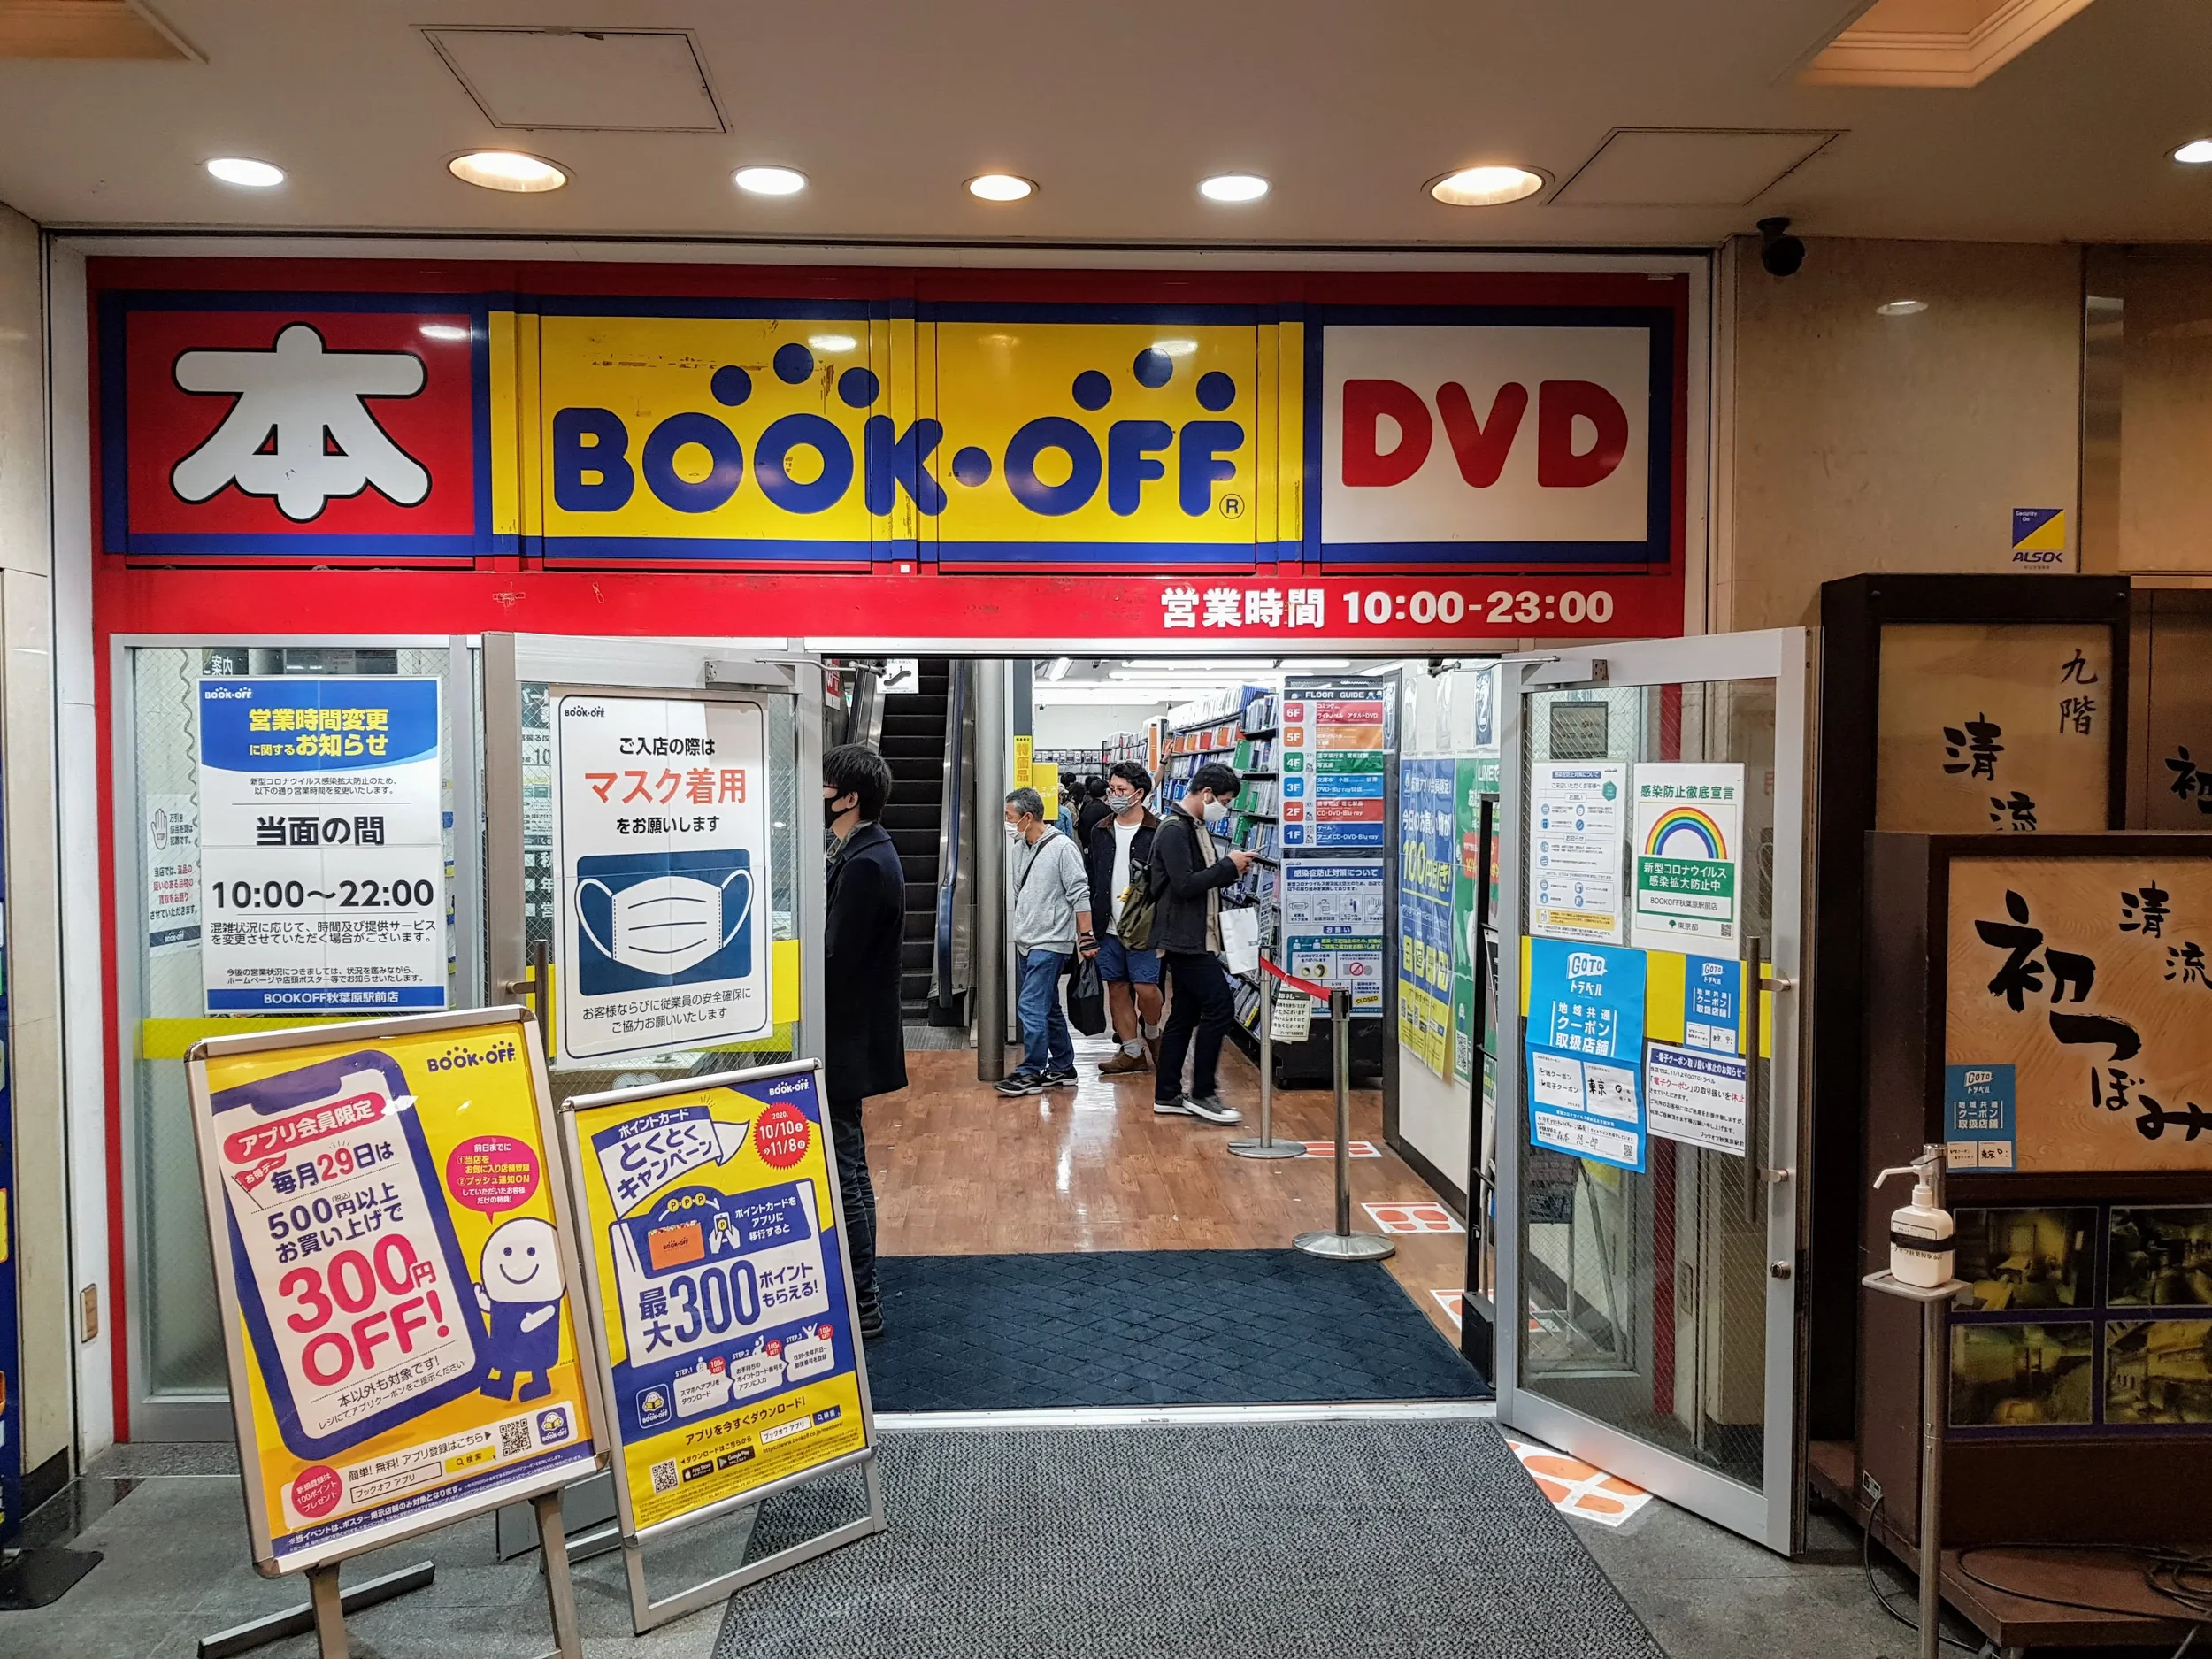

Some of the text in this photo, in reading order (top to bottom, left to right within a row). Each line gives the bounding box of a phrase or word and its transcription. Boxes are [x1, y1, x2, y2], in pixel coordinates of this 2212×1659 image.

[172, 320, 432, 523] 本
[1342, 379, 1629, 488] DVD
[2012, 552, 2063, 563] ALSOK
[1160, 588, 1615, 629] 営業時間 10:00-23:00
[204, 655, 233, 675] 案内
[2060, 649, 2098, 735] 九階
[249, 709, 389, 732] 営業時間変更
[1286, 709, 1300, 718] 6F
[250, 735, 388, 756] に関するお知らせ
[619, 737, 716, 756] ご入店の際は
[1286, 758, 1300, 767] 4F
[250, 777, 397, 786] 新型コロナウイルス感染拡大防止のため、
[585, 768, 746, 804] マスク着用
[1286, 783, 1301, 792] 3F
[1640, 785, 1735, 800] 感染防止徹底宣言
[1286, 808, 1301, 817] 2F
[256, 816, 385, 846] 当面の間
[616, 815, 720, 833] をお願いします
[1286, 831, 1301, 840] 1F
[1644, 862, 1727, 879] 新型コロナウイルス
[1649, 875, 1721, 892] 感染拡大防止中
[1650, 897, 1717, 910] BOOKOFF秋葉原駅前店
[210, 921, 436, 933] 混雑状況に応じて、時間及び提供サービス
[1678, 921, 1698, 931] 東京都
[2119, 879, 2212, 989] 清流
[211, 933, 432, 945] を変更させていただく場合がございます。
[264, 991, 399, 1004] BOOKOFF秋葉原駅前店
[1570, 980, 1602, 997] トラベル
[583, 988, 751, 1020] お客様ならびに従業員の安全確保に
[611, 1007, 727, 1033] ご協力お願いいたします
[1557, 1015, 1609, 1036] クーポン
[1555, 1032, 1609, 1056] 取扱店舗
[1546, 1081, 1578, 1094] 電子クーポン
[1587, 1078, 1607, 1096] 東京
[238, 1100, 375, 1156] アプリ会員限定
[618, 1109, 689, 1139] ポイントカード
[474, 1143, 511, 1153] 前日までに
[620, 1124, 698, 1171] とくとく
[244, 1159, 280, 1184] お得デー
[271, 1141, 394, 1194] 毎月29日は
[617, 1141, 713, 1200] キャンペーン
[462, 1187, 526, 1196] していただいたお客様
[268, 1182, 399, 1240] 500円以上
[735, 1196, 796, 1219] ポイントカードを
[751, 1213, 784, 1228] アプリに
[276, 1202, 403, 1263] お買い上げで
[749, 1225, 790, 1242] 移行すると
[279, 1233, 437, 1333] 300円
[759, 1262, 814, 1288] ポイント
[669, 1260, 761, 1343] 300
[763, 1279, 818, 1307] もらえる!
[639, 1286, 672, 1353] 最大
[302, 1289, 449, 1386] OFF!
[337, 1356, 440, 1408] 本以外も対象です!
[737, 1363, 783, 1382] ポイントカード番号を
[680, 1379, 720, 1396] スマホへアプリを
[738, 1377, 766, 1391] アプリに入力
[681, 1392, 711, 1405] ダウンロード
[686, 1396, 806, 1446] アプリを今すぐダウンロード!
[764, 1421, 805, 1440] ブックオフ アプリ
[349, 1432, 485, 1482] 簡単! 無料! アプリ登録はこちら
[466, 1453, 482, 1463] 検索
[296, 1473, 332, 1494] 新規登録は
[297, 1481, 338, 1504] 100ポイント
[356, 1474, 416, 1498] ブックオフ アプリ
[303, 1492, 338, 1513] プレゼント
